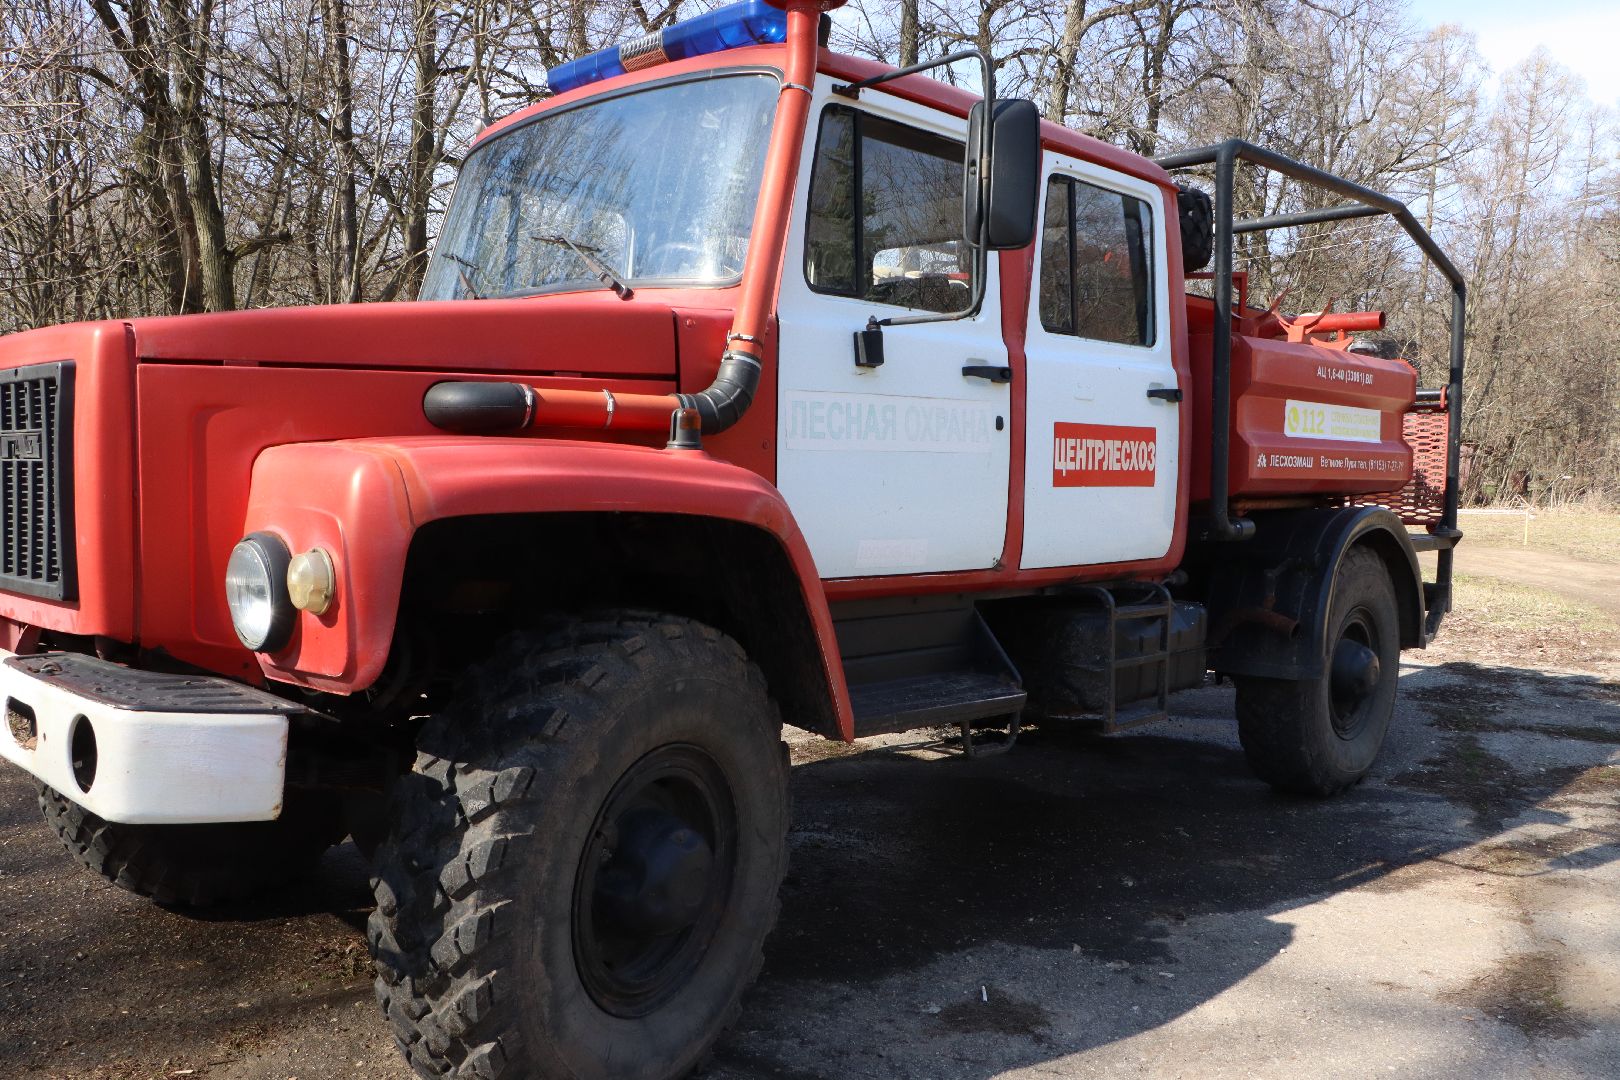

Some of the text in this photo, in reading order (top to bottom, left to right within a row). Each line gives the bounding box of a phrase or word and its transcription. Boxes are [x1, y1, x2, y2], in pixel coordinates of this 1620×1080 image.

[789, 400, 990, 442] ЛЕСНАЯ ОХРАНА
[1302, 408, 1326, 434] 112
[1054, 437, 1156, 477] ЦЕНТРЛЕСХОЗ
[1269, 454, 1314, 468] ЛЕСХОЗМАШ
